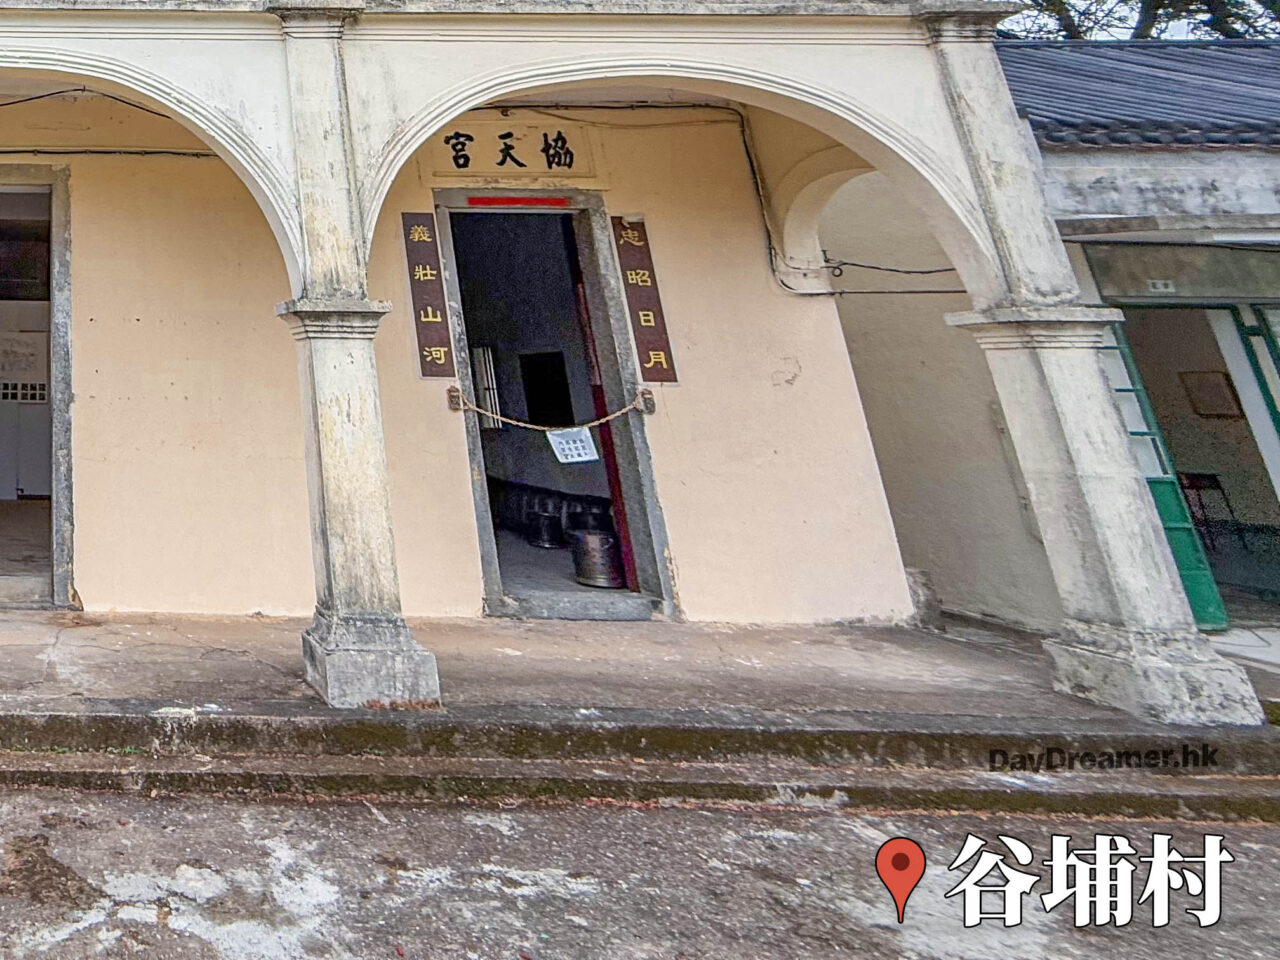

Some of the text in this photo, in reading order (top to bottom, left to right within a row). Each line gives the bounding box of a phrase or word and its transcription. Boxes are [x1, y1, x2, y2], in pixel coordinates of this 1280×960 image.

[443, 130, 574, 169] 協天宮
[409, 225, 448, 365] 義壯山河
[620, 229, 668, 370] 忠昭日月
